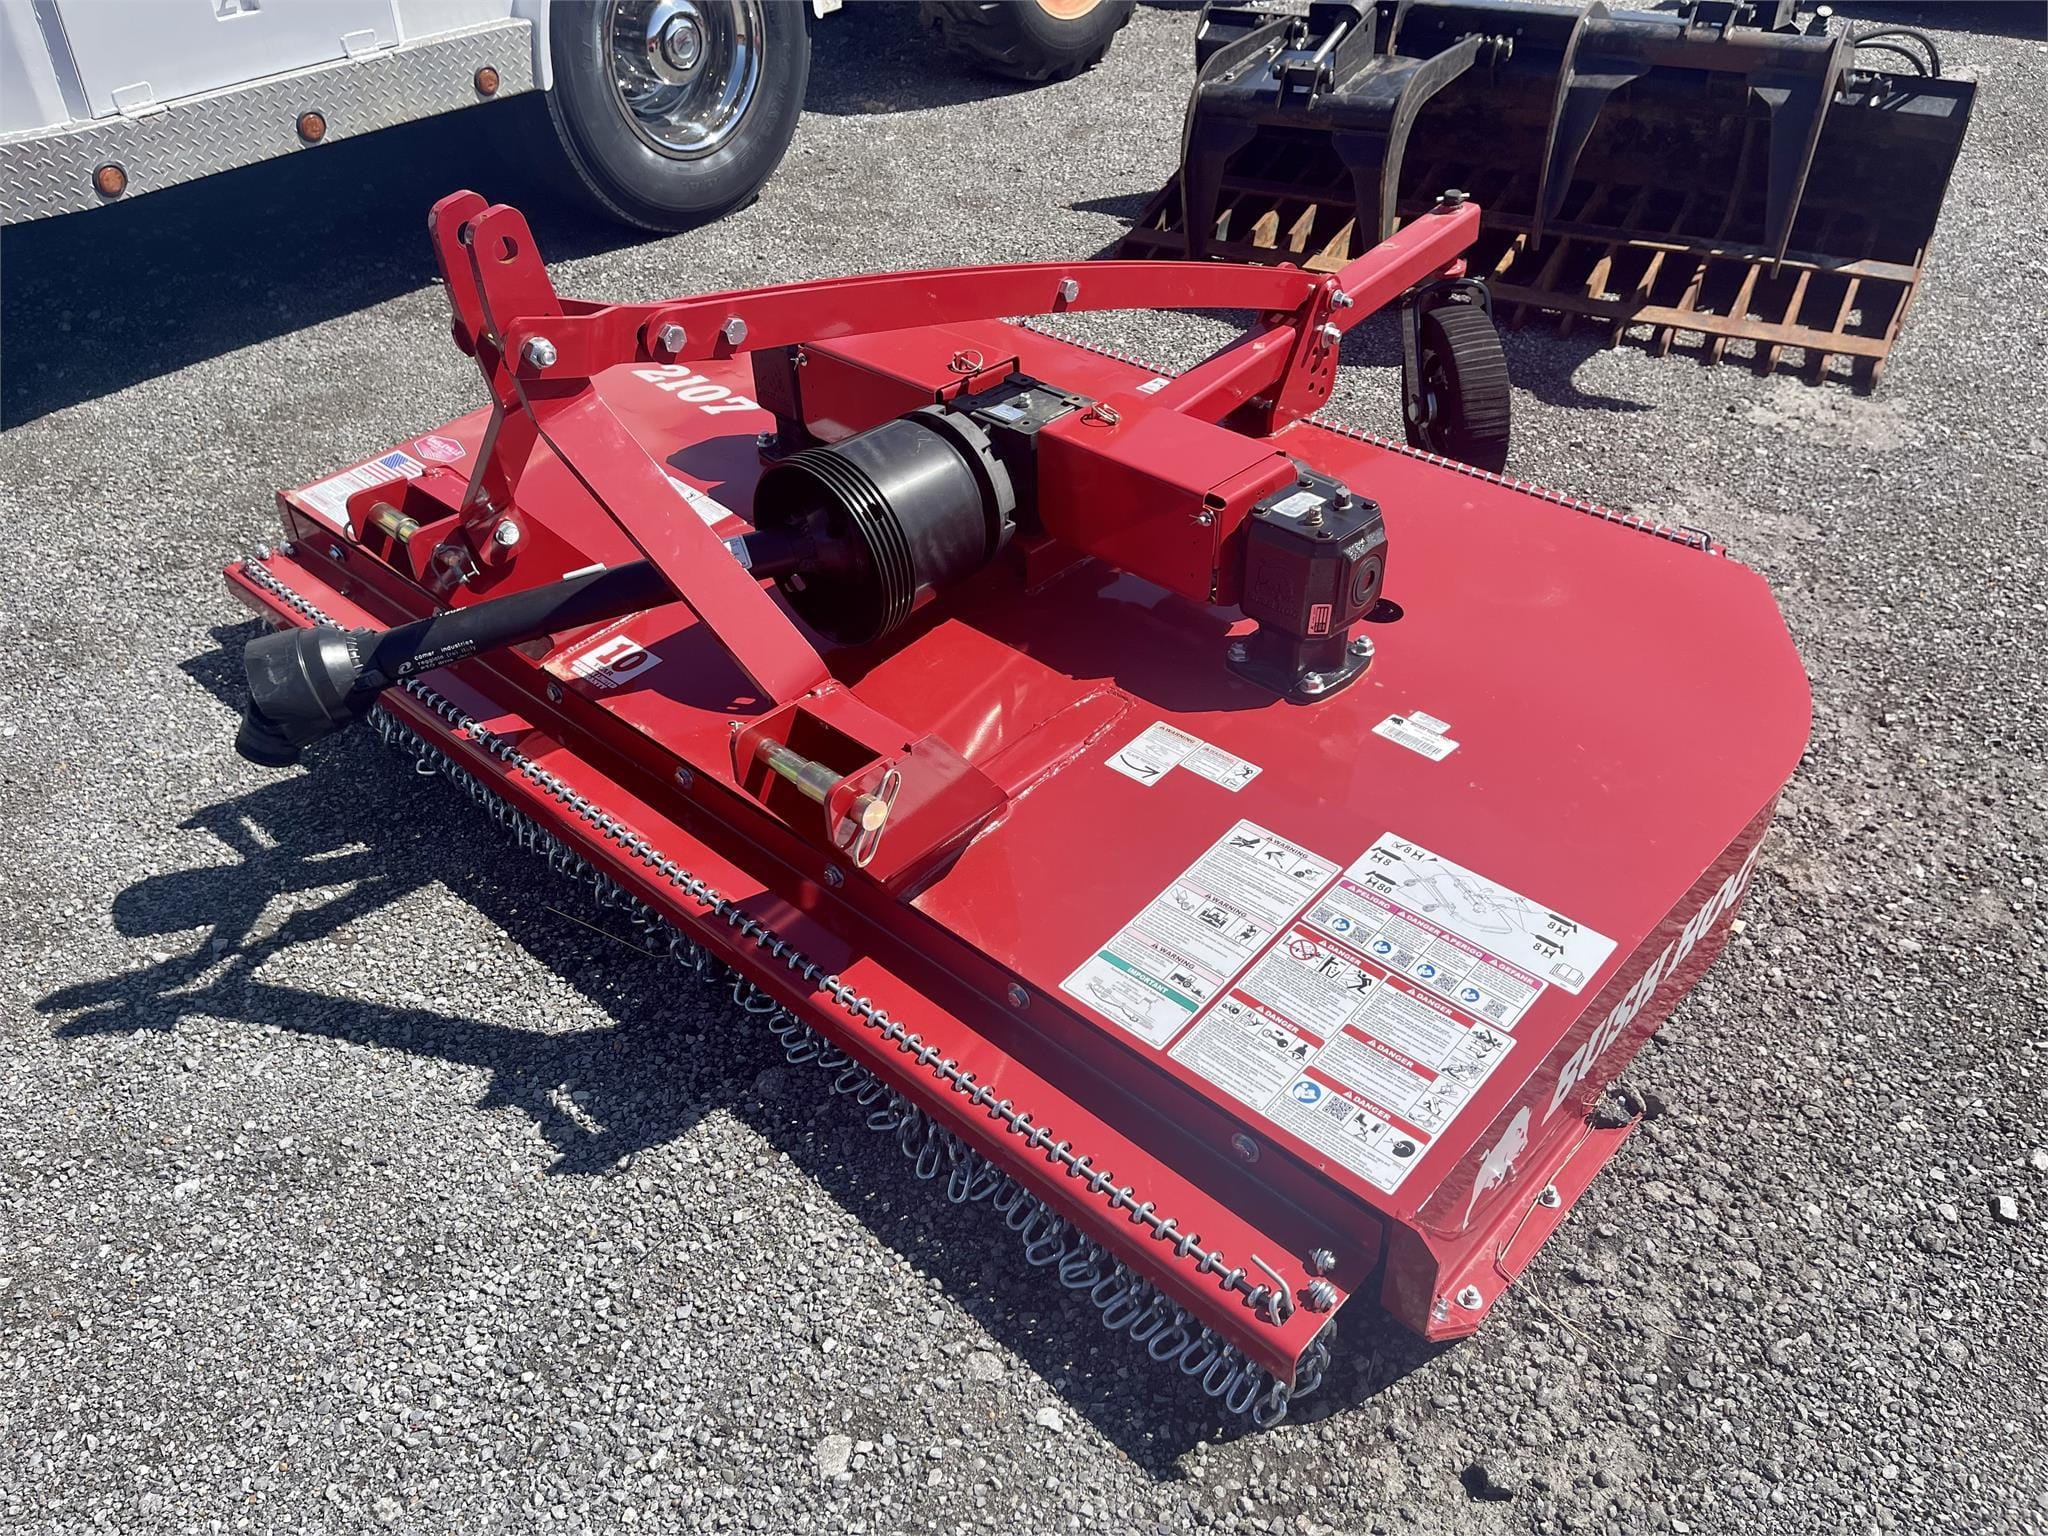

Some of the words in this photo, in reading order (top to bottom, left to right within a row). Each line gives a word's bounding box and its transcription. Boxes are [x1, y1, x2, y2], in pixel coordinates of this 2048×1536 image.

[631, 365, 762, 415] 2107
[414, 650, 435, 661] comer
[440, 639, 474, 652] industries
[595, 643, 648, 672] 10
[1166, 728, 1196, 744] WARNING
[1271, 838, 1309, 860] WARNING
[1404, 846, 1412, 854] 8
[1383, 858, 1392, 866] 8
[1356, 888, 1391, 909] PELIGRO
[1377, 884, 1392, 894] 80
[1212, 896, 1247, 918] WARNING
[1406, 914, 1442, 935] DANGER
[1547, 922, 1556, 930] 8
[1327, 944, 1362, 966] DANGER
[1449, 937, 1484, 957] PERIGO
[1533, 942, 1541, 951] 8
[1160, 946, 1196, 970] WARNING
[1127, 967, 1169, 994] IMPORTANT
[1499, 961, 1534, 984] GEFAHR
[1416, 993, 1454, 1016] DANGER
[1264, 1008, 1300, 1033] DANGER
[1541, 940, 1675, 1127] BUSH
[1377, 1044, 1414, 1068] DANGER
[1353, 1097, 1392, 1121] DANGER
